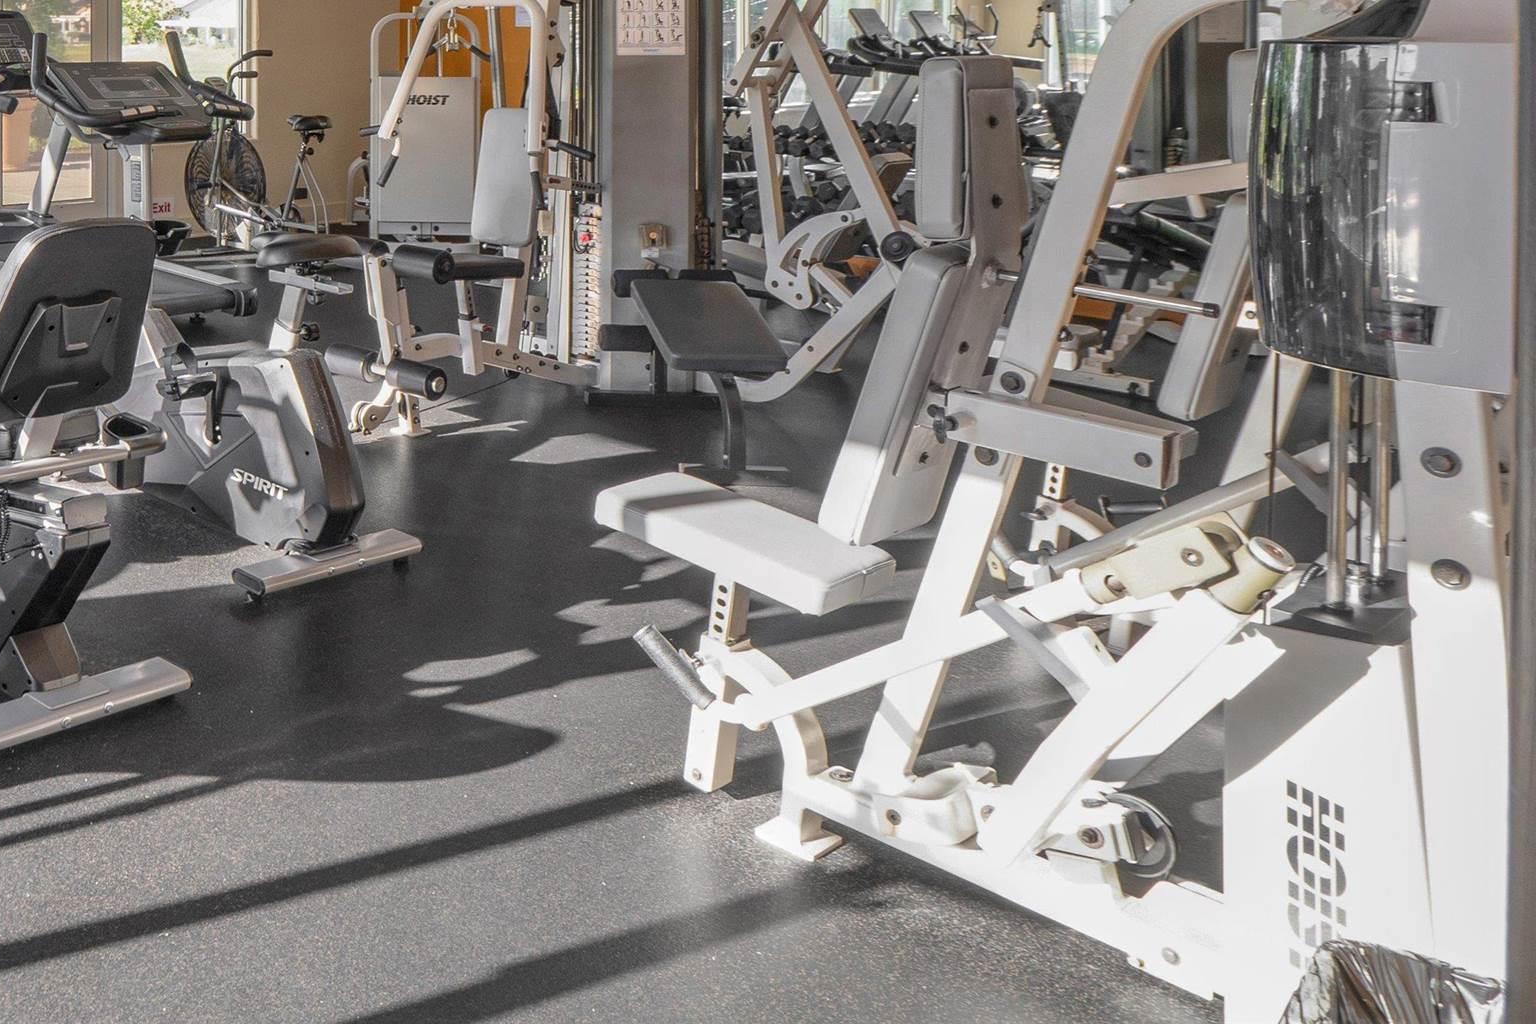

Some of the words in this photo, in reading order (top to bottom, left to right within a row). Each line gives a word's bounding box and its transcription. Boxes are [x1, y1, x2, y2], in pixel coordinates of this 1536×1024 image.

[406, 94, 450, 106] HOIST
[152, 202, 171, 214] Exit
[230, 467, 289, 501] SPIRIT
